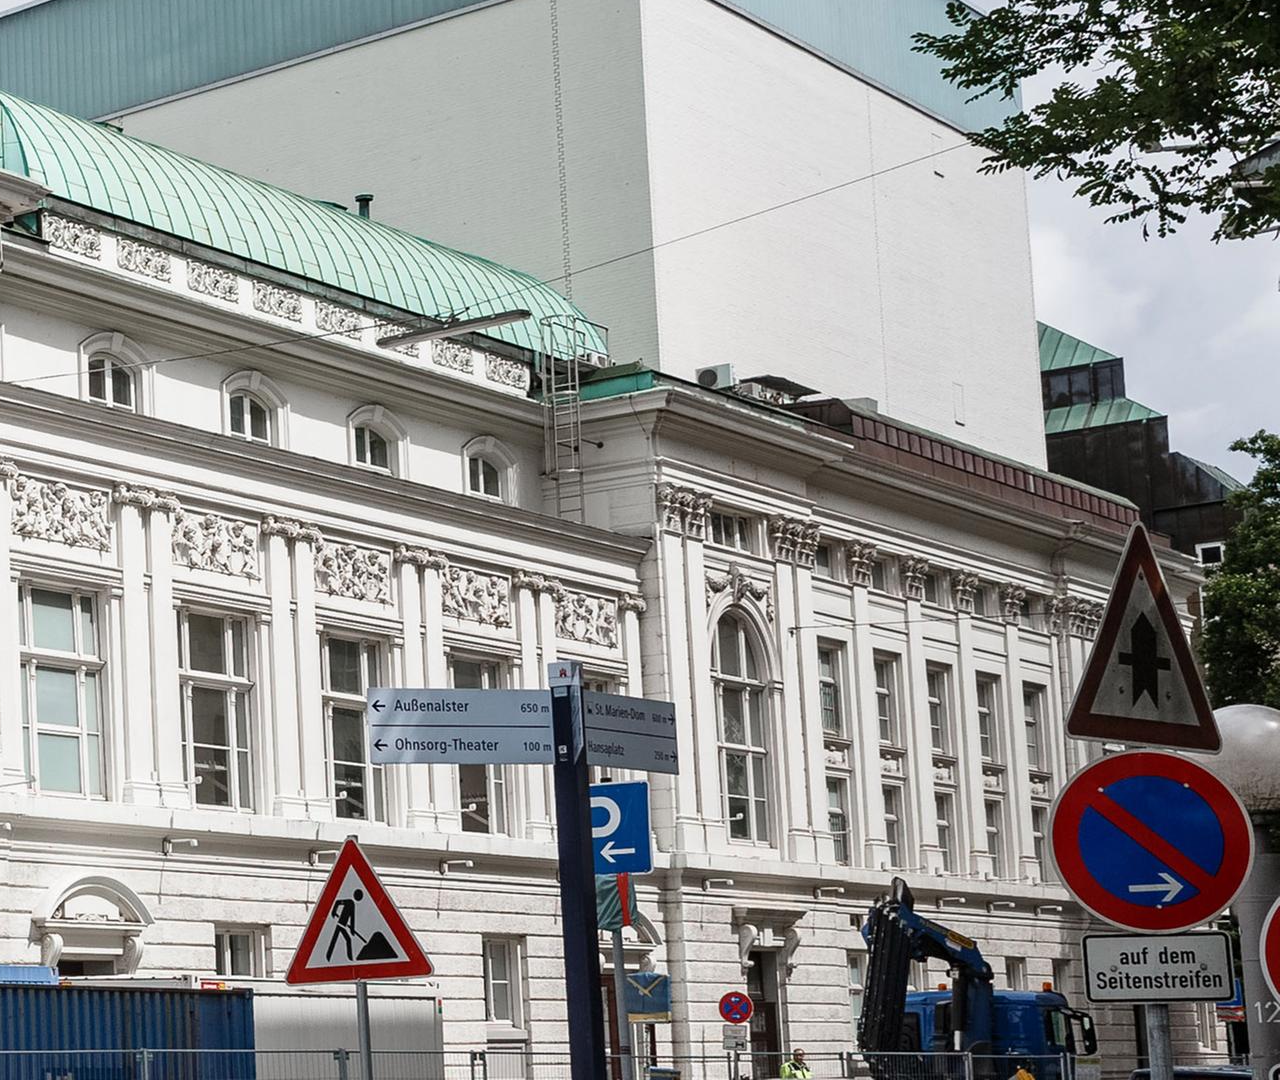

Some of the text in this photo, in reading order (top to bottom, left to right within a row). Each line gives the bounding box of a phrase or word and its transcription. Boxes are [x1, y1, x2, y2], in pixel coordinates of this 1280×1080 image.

[394, 699, 469, 713] Außenalster
[520, 703, 538, 713] 650
[595, 703, 604, 716] St.
[605, 704, 645, 721] Marien-Dom
[395, 738, 499, 754] Ohnsorg-Theater
[523, 742, 540, 752] 100
[587, 741, 625, 758] Hansaplatz
[1119, 946, 1196, 965] auf dem
[1096, 970, 1223, 990] Seitenstreifen
